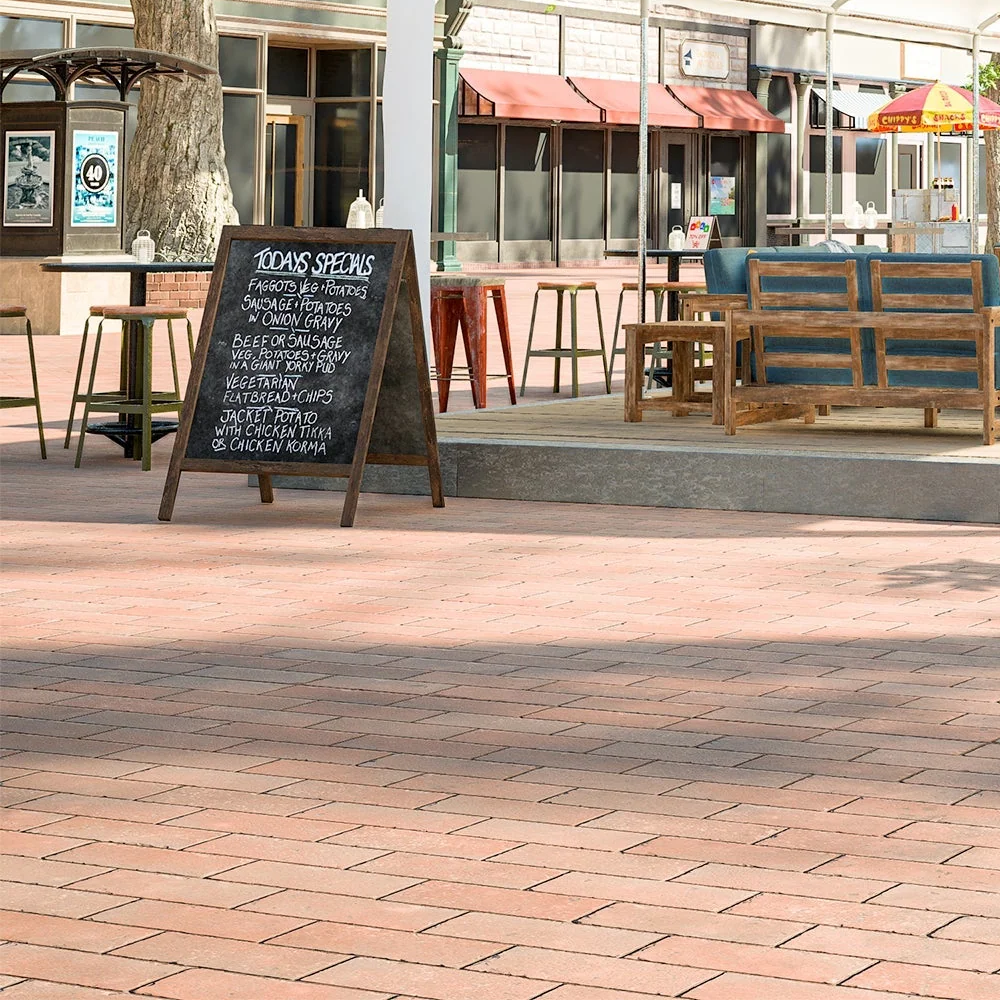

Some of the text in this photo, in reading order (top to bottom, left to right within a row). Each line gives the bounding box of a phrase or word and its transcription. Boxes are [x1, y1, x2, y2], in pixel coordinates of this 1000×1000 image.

[881, 116, 917, 125] CHIPPY'S
[933, 114, 966, 122] SNACKS
[86, 165, 103, 182] 40
[253, 246, 376, 277] TODAYS SPECIALS
[247, 278, 297, 295] FAGGOTS
[299, 277, 319, 294] VEG
[241, 295, 294, 312] SAUSAGE
[300, 297, 352, 317] POTATOES
[261, 311, 303, 327] ONION
[304, 313, 344, 334] GRAVY
[232, 333, 343, 351] BEEF OR SAUSAGE
[258, 347, 310, 361] POTATOES
[316, 350, 352, 364] GRAVY
[229, 360, 336, 374] IN A GIANT YORKY PUD
[226, 373, 299, 391] VEGETARIAN
[222, 390, 290, 404] FLATBREAD
[297, 389, 334, 404] CHIPS
[220, 409, 318, 426] JACKET POTATO
[215, 423, 332, 440] WITH CHICKEN TIKKA
[211, 437, 326, 456] OR CHICKEN KORMA
